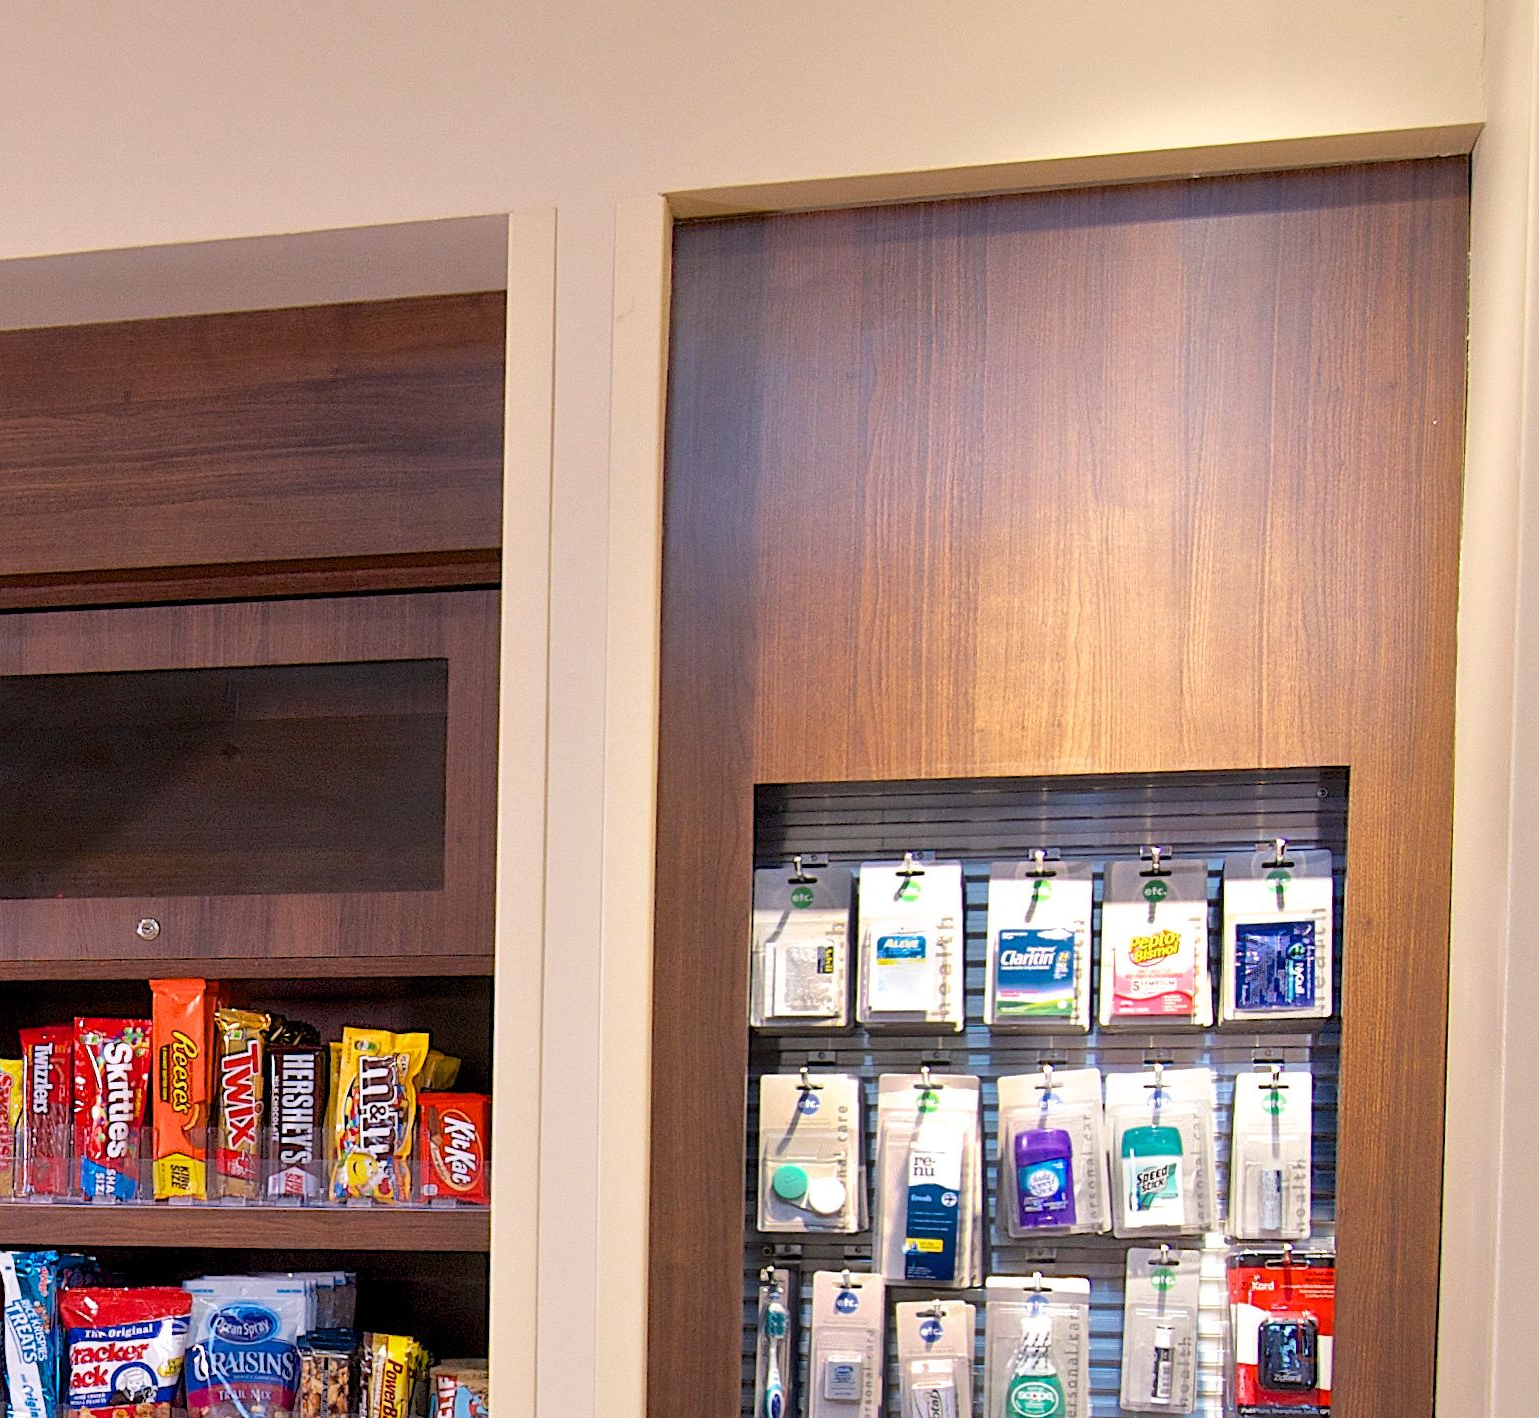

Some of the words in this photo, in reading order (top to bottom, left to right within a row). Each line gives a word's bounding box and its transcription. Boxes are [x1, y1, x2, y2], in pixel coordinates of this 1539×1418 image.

[1144, 887, 1166, 896] etc.
[1000, 950, 1056, 966] Claritin
[1134, 944, 1178, 963] Bismol
[1132, 981, 1140, 991] 5
[33, 1042, 54, 1114] Twizzlers
[172, 1030, 199, 1115] Reese's
[103, 1042, 133, 1158] Skittles
[221, 1040, 261, 1148] TWIX
[280, 1054, 315, 1166] HERSHEY'S
[837, 1105, 848, 1142] care
[171, 1164, 180, 1188] SIZE
[913, 1166, 935, 1177] nu
[836, 1299, 858, 1308] etc.
[5, 1300, 38, 1365] TREATS
[20, 1299, 33, 1321] RICE
[31, 1320, 48, 1362] KRISPIES
[108, 1322, 153, 1338] Original
[215, 1316, 242, 1335] Ocean
[243, 1318, 269, 1338] Spray
[71, 1365, 109, 1389] ack
[193, 1350, 294, 1381] CRAISINS
[251, 1388, 271, 1401] MIX
